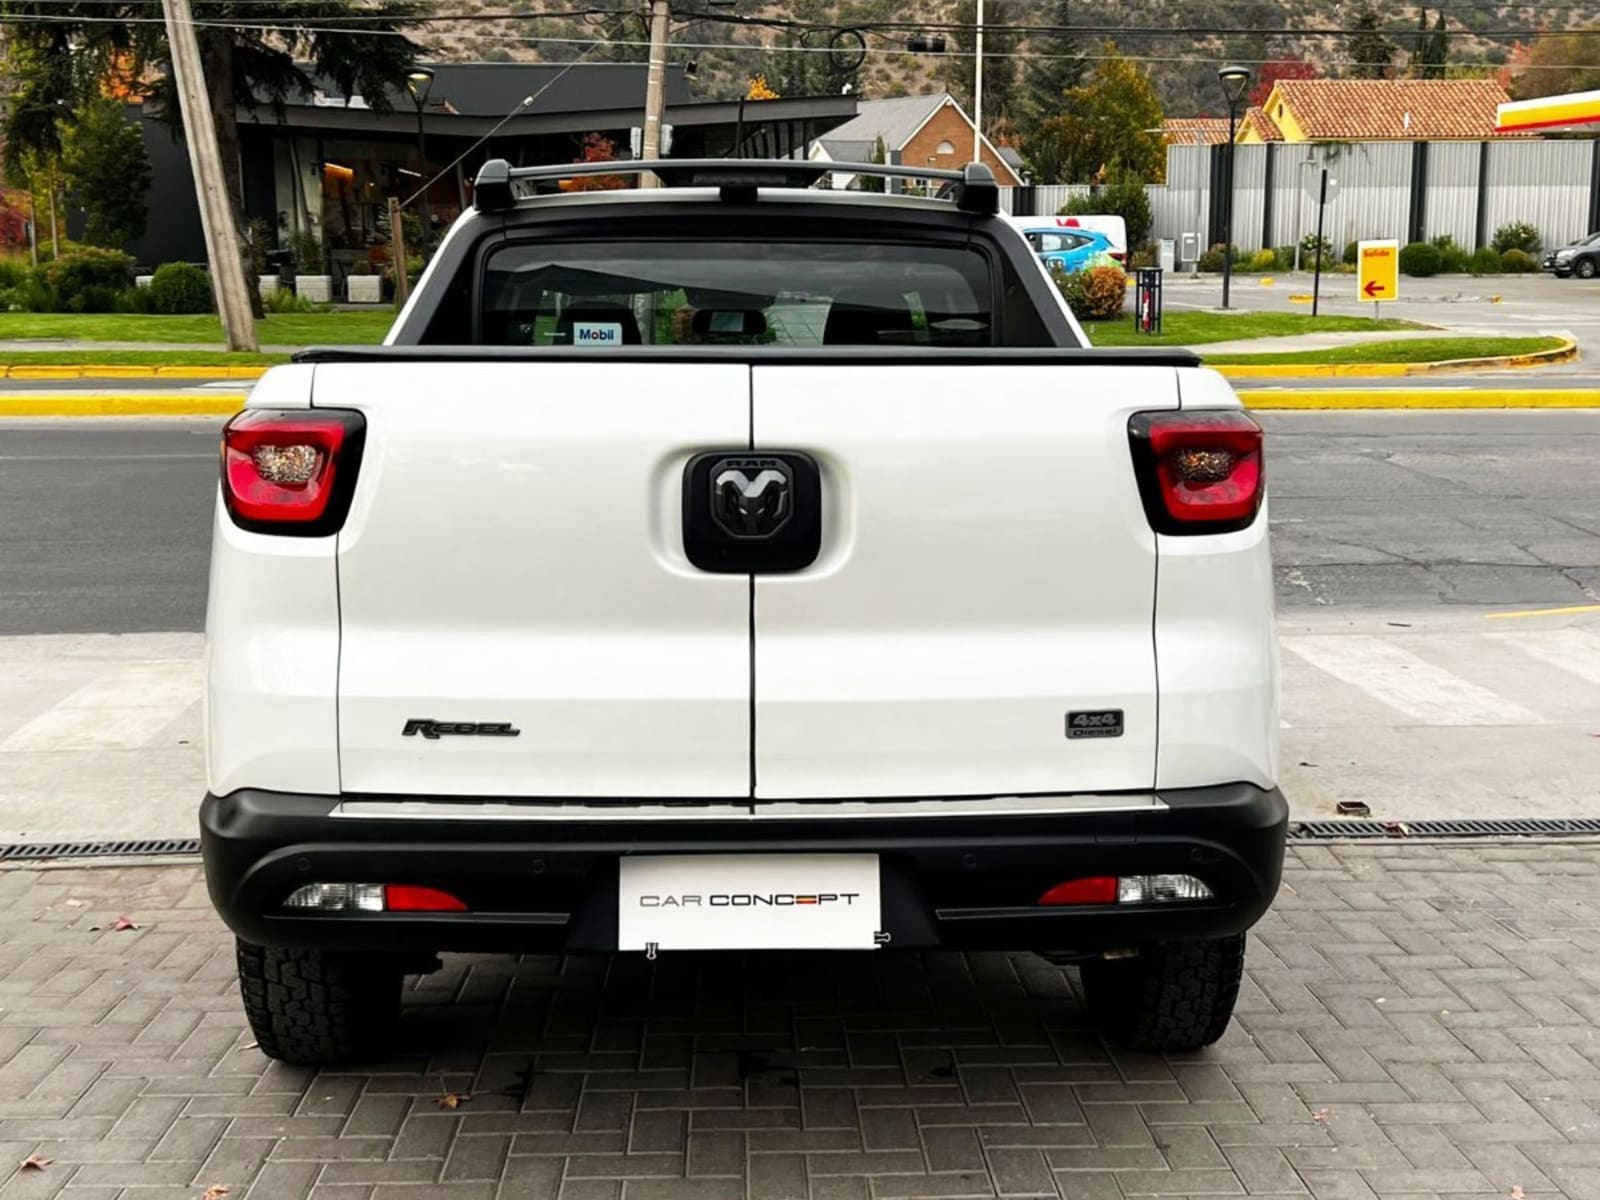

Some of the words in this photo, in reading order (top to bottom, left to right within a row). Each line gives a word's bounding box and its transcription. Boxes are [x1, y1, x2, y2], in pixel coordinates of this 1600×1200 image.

[579, 328, 614, 341] Mobil
[402, 718, 521, 739] REBEL
[639, 895, 703, 908] CAR
[709, 893, 860, 907] CONCEPT
